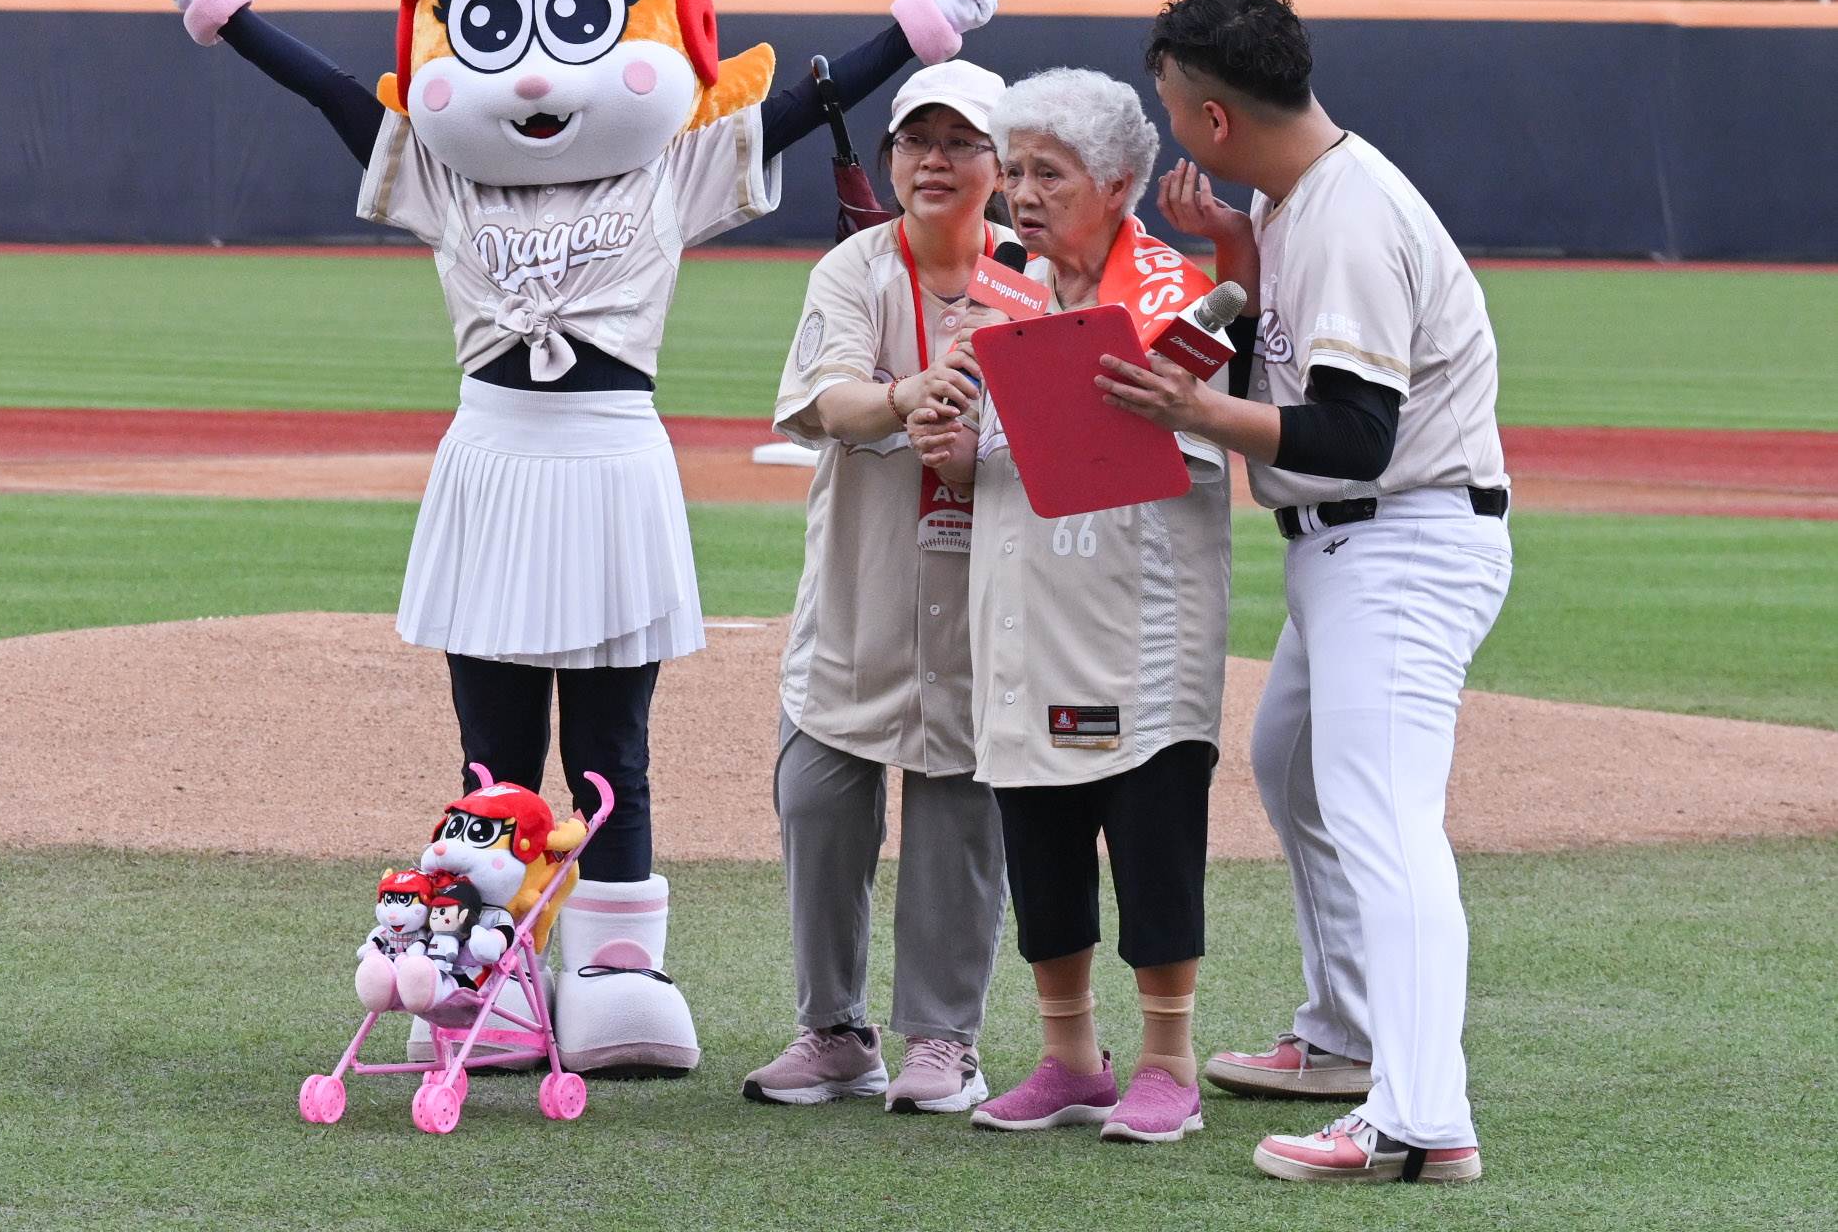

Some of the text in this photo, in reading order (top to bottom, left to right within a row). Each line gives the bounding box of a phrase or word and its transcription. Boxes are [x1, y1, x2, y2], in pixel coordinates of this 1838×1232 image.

[473, 212, 638, 293] Dragons
[976, 270, 1042, 311] Be supporters!
[1169, 335, 1219, 366] DRAGONS
[1052, 514, 1097, 557] 66
